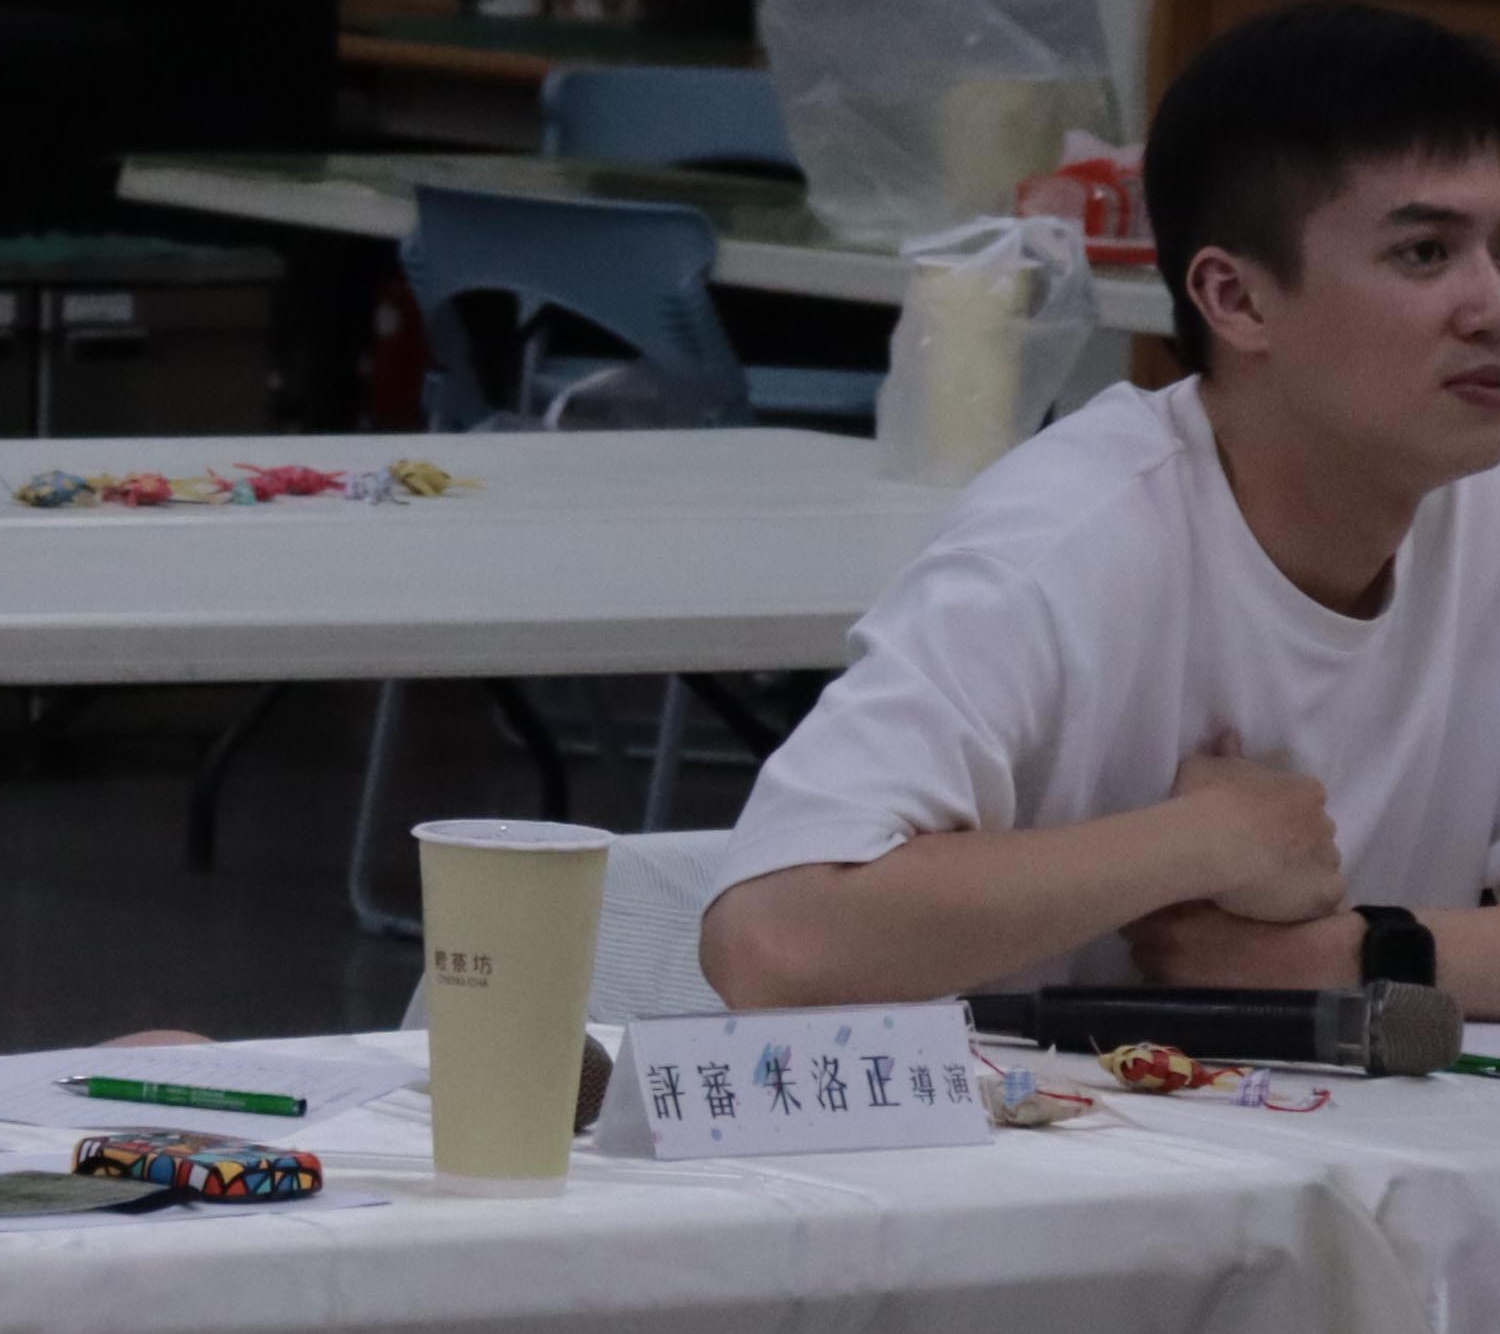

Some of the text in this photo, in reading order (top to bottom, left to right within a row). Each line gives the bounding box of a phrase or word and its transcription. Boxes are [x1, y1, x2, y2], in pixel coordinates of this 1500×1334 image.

[648, 1055, 974, 1121] 評審 朱洛正導演
